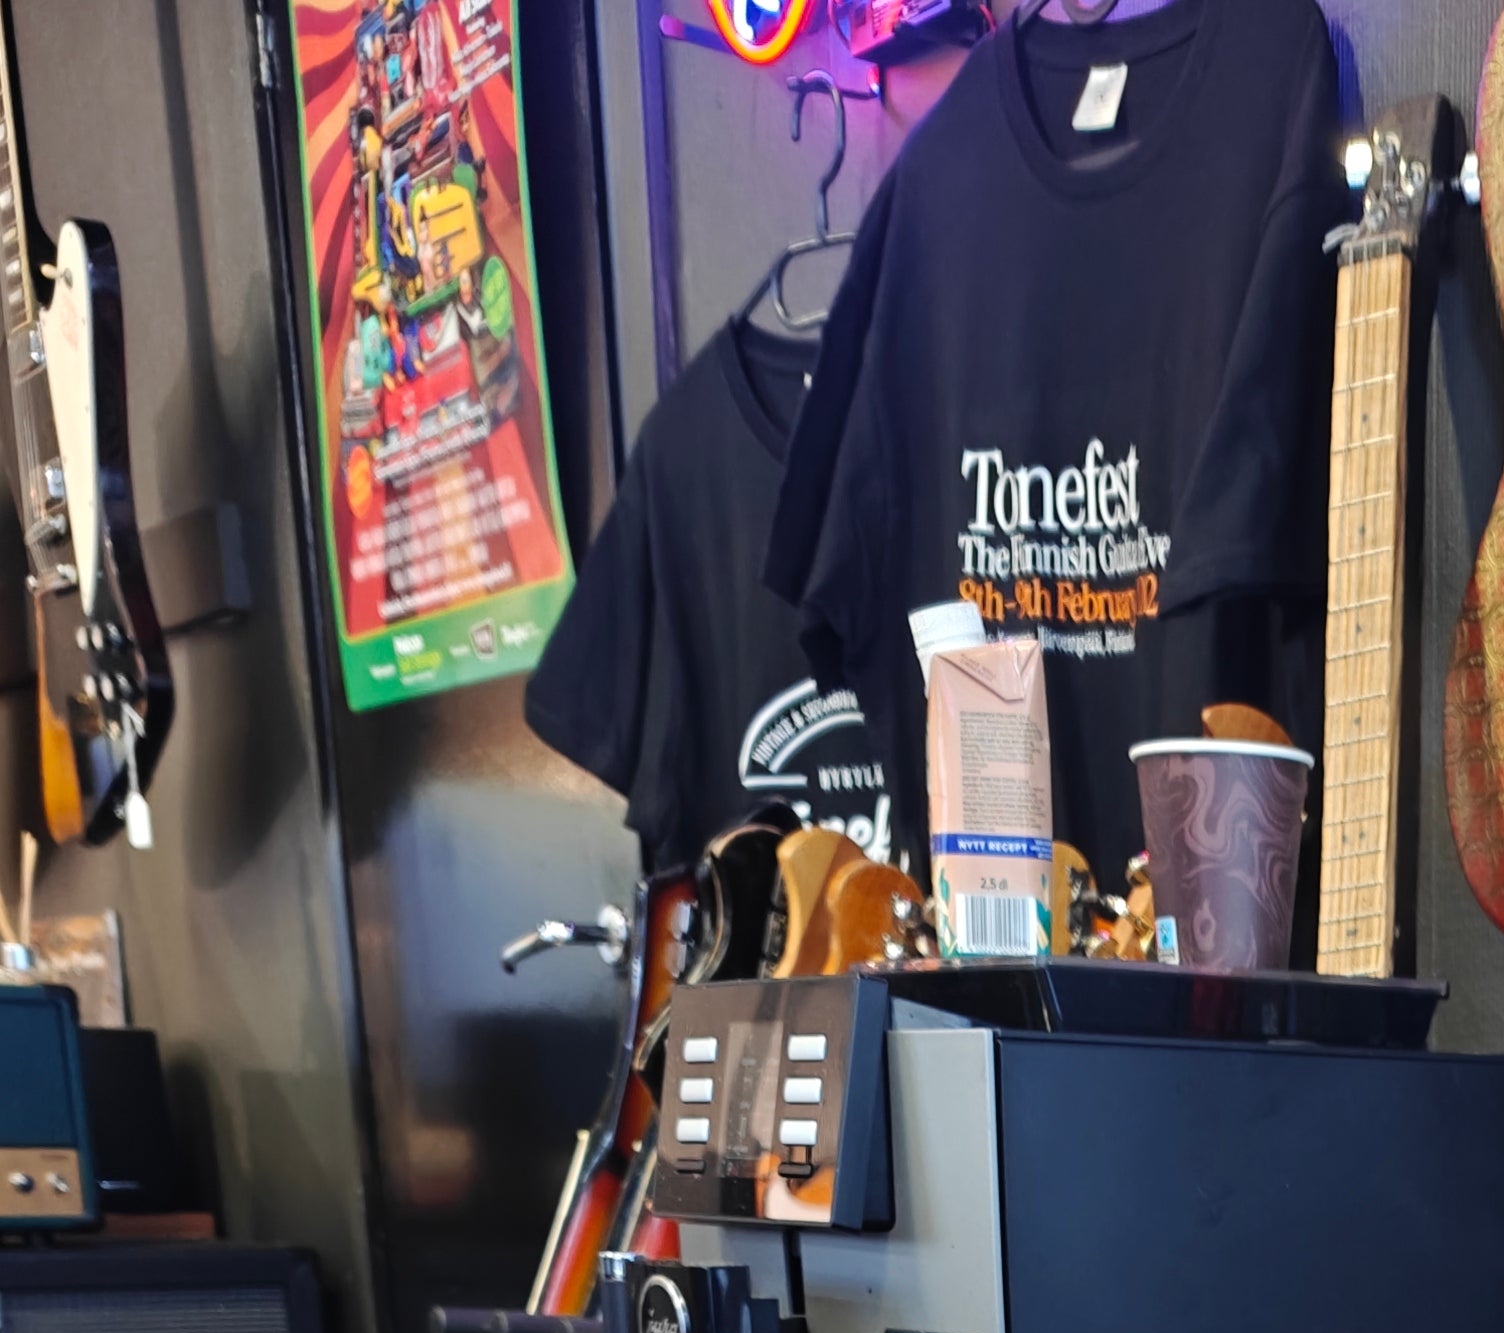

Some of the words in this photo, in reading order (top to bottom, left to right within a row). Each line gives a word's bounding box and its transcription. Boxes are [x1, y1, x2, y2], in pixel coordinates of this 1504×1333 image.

[961, 437, 1140, 534] Tonefest
[958, 532, 1010, 580] The
[957, 839, 987, 853] NYTT
